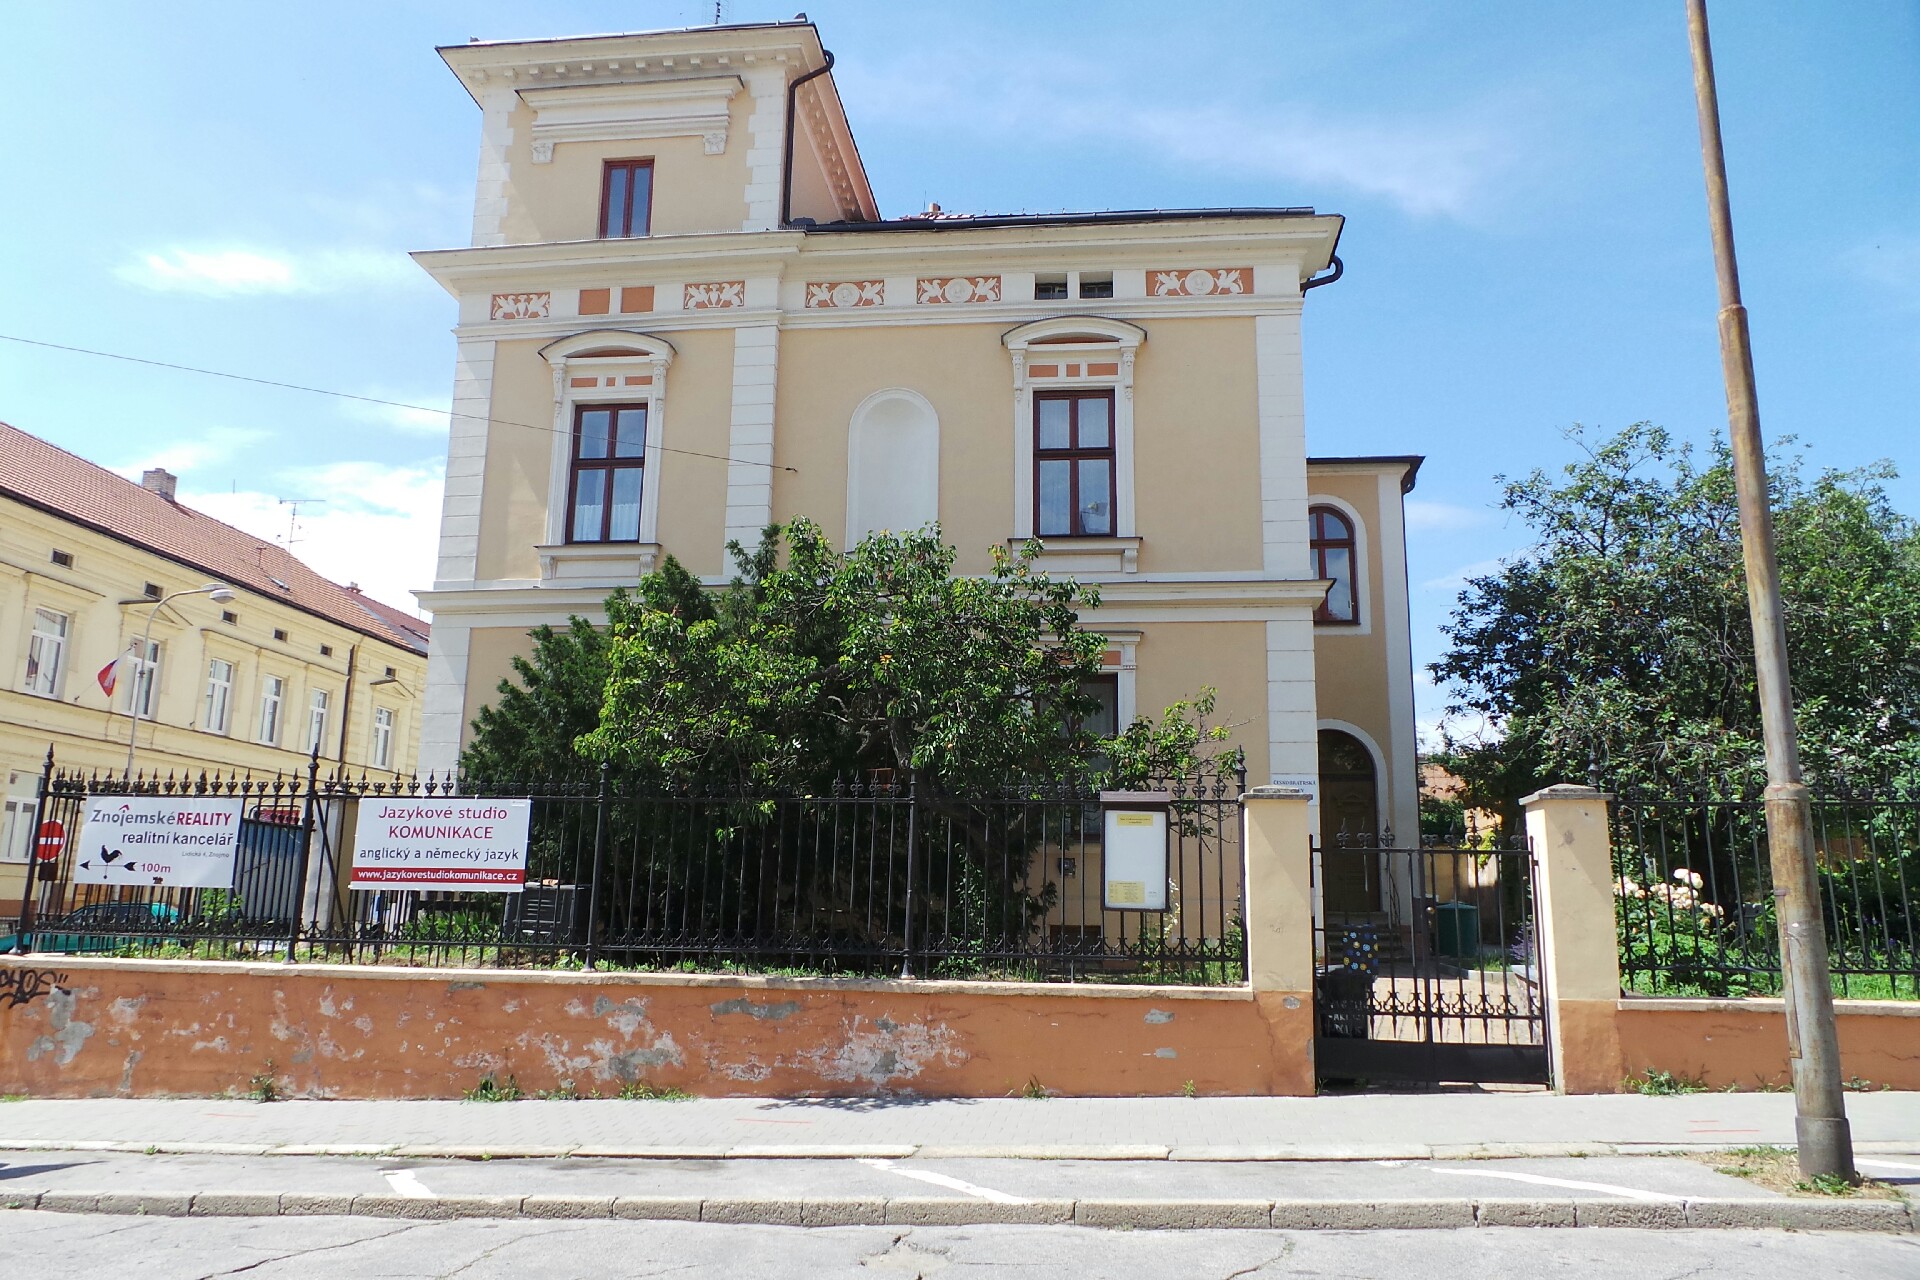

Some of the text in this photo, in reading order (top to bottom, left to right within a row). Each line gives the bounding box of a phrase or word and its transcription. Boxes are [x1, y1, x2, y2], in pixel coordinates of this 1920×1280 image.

[378, 805, 508, 821] Jazykové studio
[122, 832, 234, 846] realitní kancelář
[389, 825, 494, 839] KOMUNIKACE
[360, 847, 519, 862] anglický a německý jazyk
[141, 863, 171, 873] 100m
[358, 869, 518, 881] www.jazykovestudiokomunikace.cz
